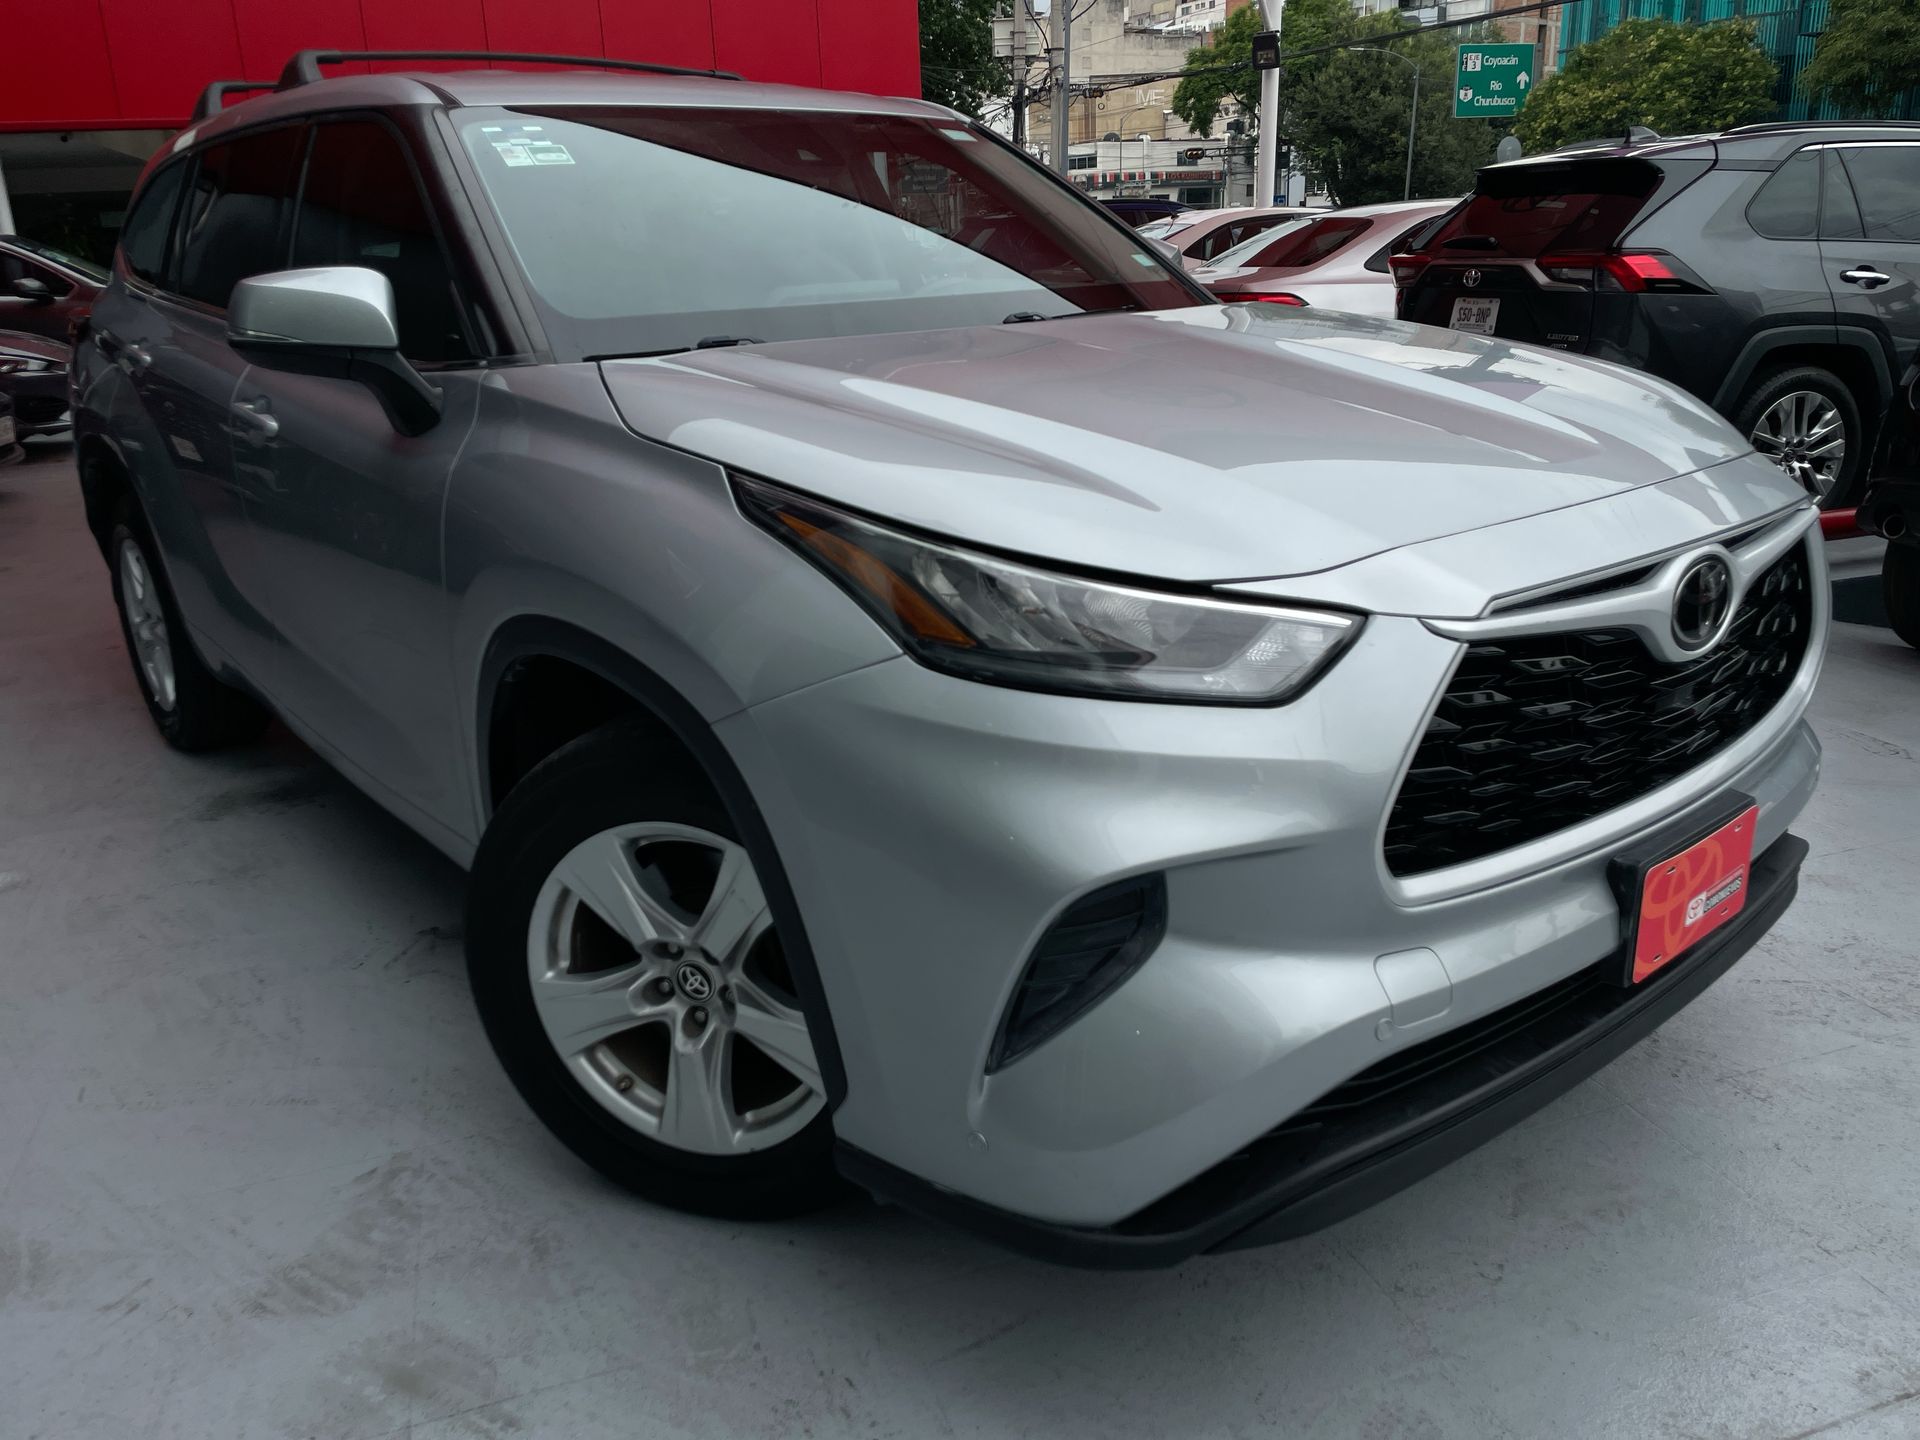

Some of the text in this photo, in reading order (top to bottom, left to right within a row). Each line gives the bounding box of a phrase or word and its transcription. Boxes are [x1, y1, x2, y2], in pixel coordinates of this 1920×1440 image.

[1471, 61, 1477, 69] 3
[1484, 55, 1518, 68] Coyoacán
[1490, 80, 1503, 91] Río
[1474, 95, 1516, 107] Churubusco
[1457, 307, 1491, 323] S50-BNP
